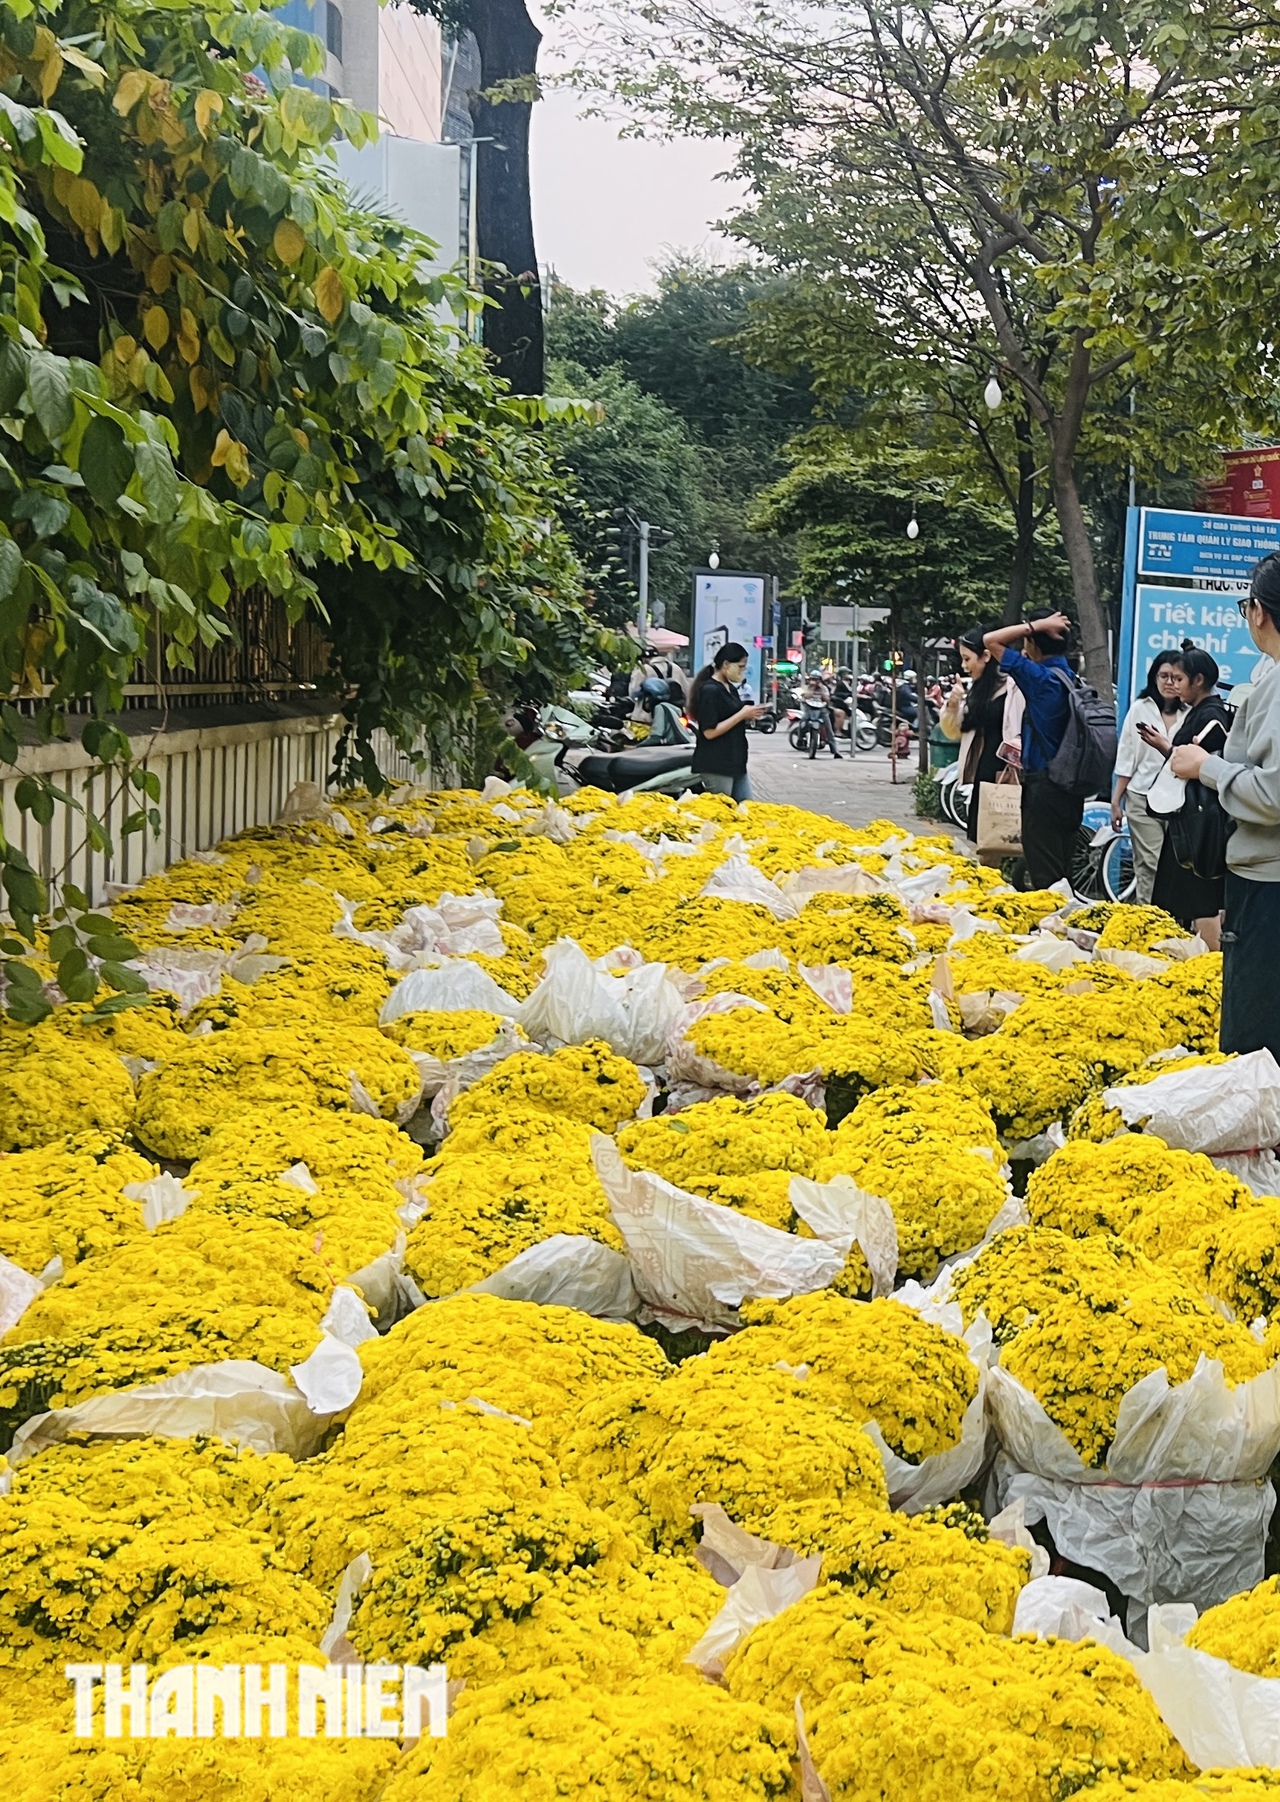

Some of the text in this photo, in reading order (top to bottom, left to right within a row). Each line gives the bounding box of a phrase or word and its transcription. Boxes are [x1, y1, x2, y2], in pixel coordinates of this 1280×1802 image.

[1148, 531, 1175, 541] TRUNG
[1232, 537, 1252, 548] GIAO
[1253, 539, 1280, 550] THÔNG
[1149, 602, 1195, 625] Tiết
